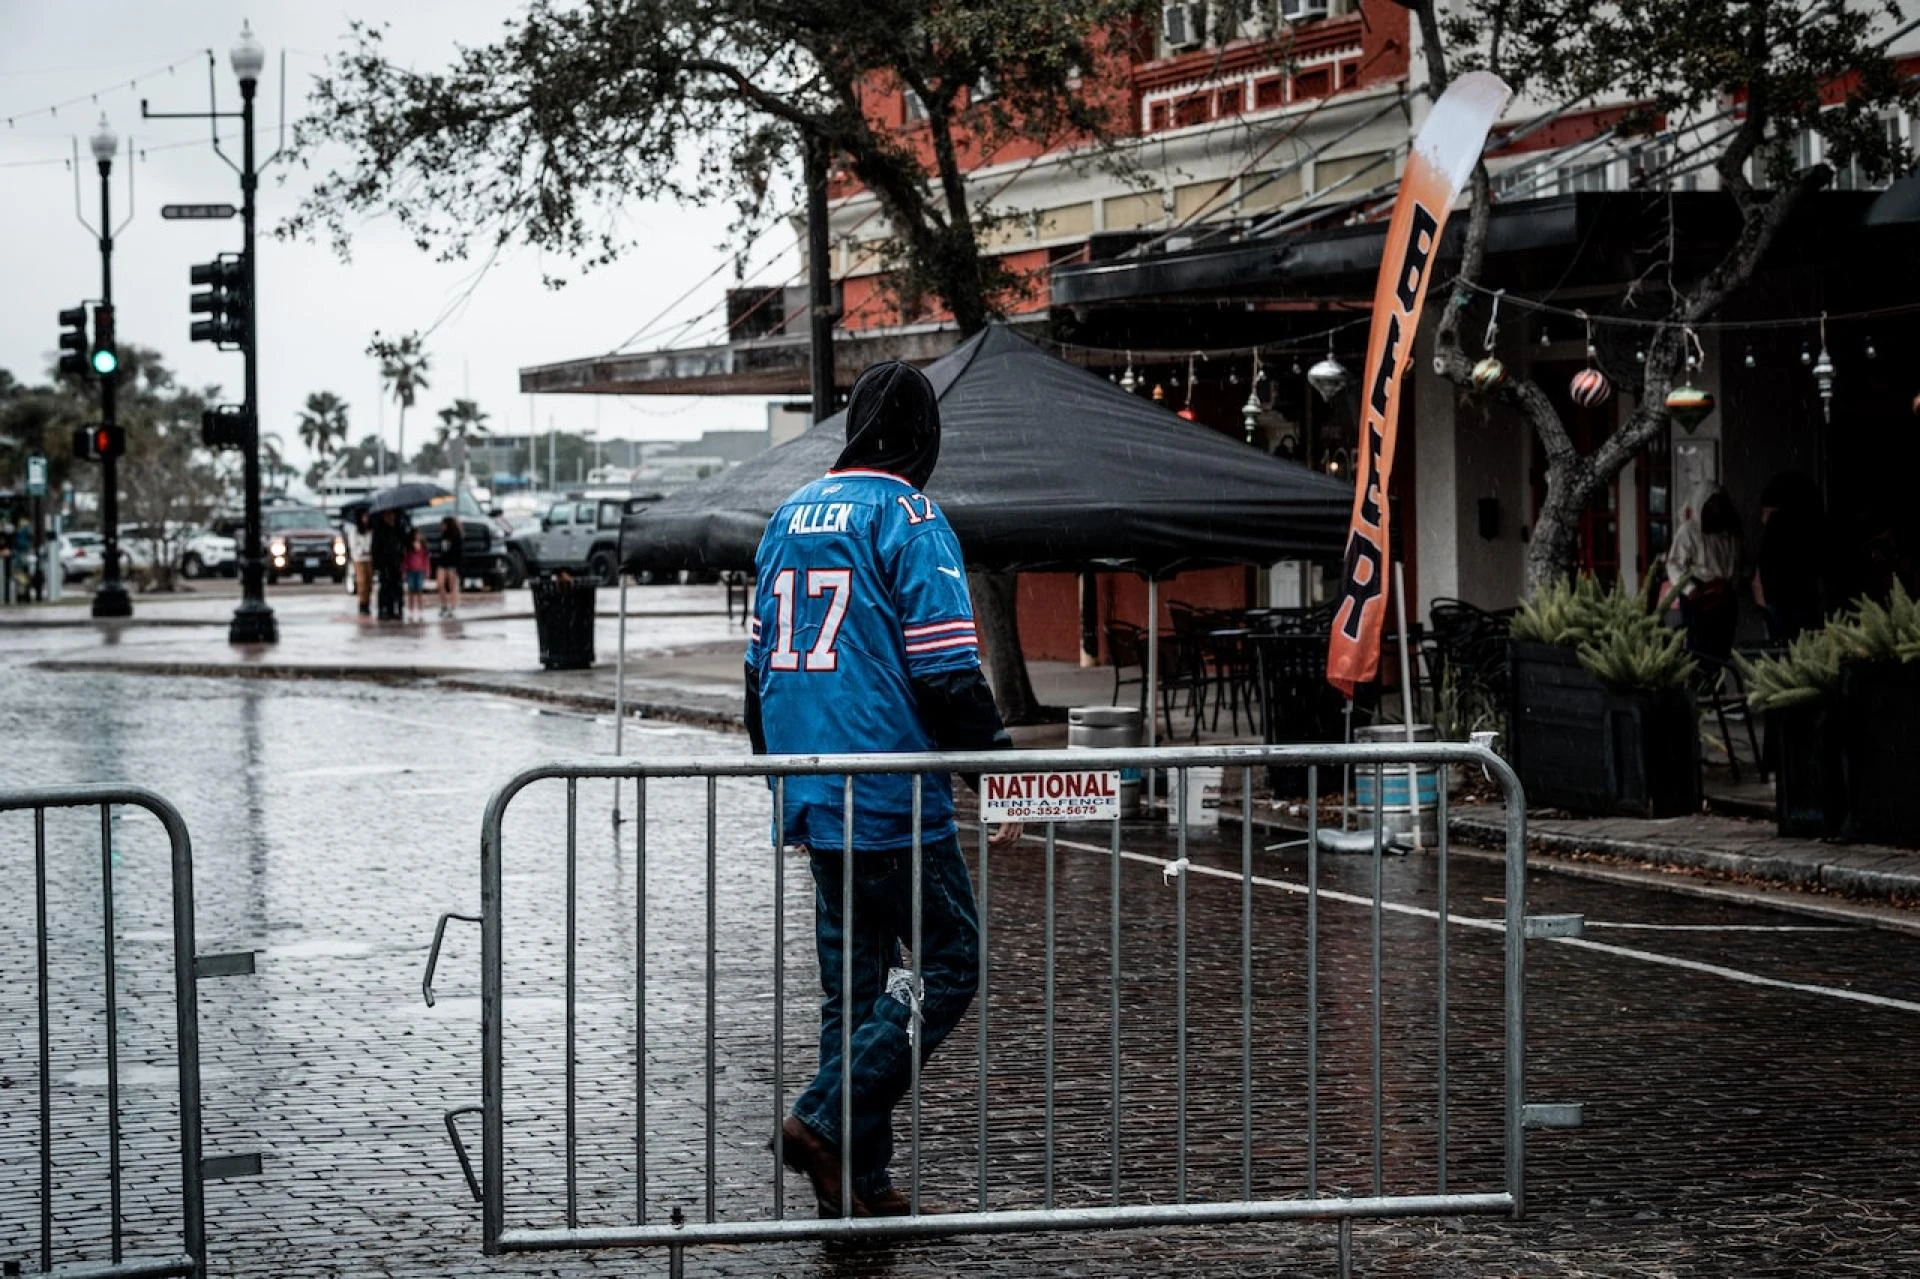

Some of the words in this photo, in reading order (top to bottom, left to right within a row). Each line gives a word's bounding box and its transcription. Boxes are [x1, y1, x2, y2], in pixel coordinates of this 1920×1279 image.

[788, 503, 853, 534] ALLEN
[897, 493, 936, 525] 17
[770, 568, 852, 672] 17
[988, 773, 1116, 800] NATIONAL
[987, 798, 1116, 808] RENT-A-FENCE
[1007, 806, 1098, 817] 800-352-5675
